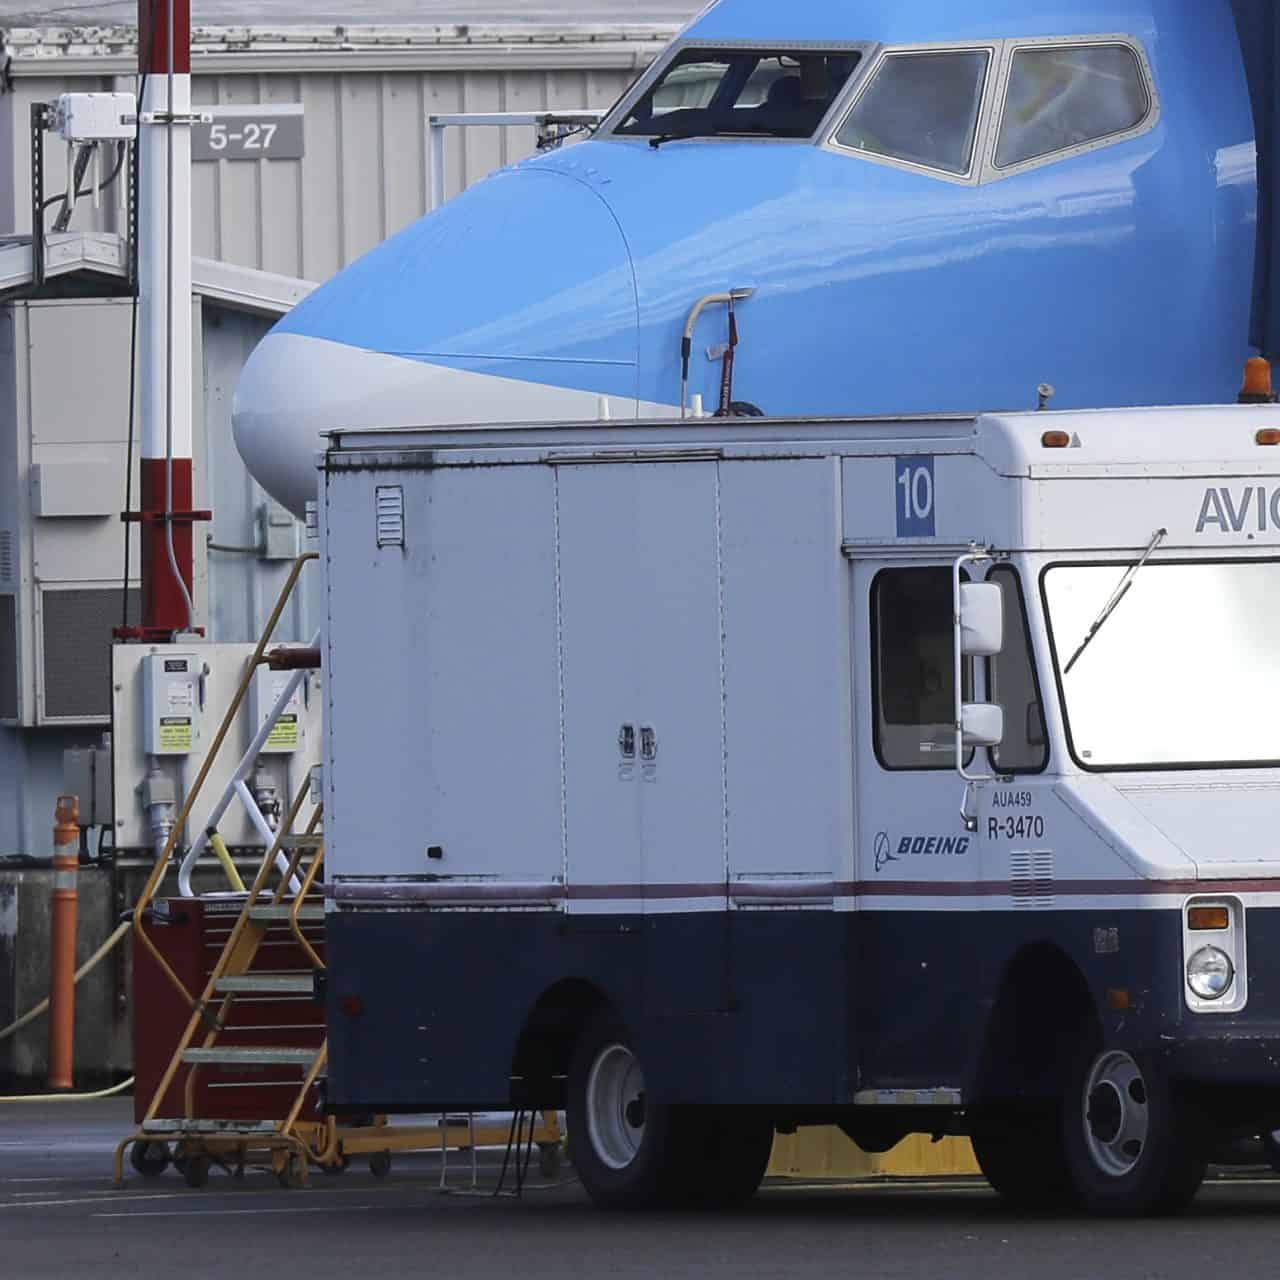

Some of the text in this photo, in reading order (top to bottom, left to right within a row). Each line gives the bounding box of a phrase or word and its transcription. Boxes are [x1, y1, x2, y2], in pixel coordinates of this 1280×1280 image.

[209, 123, 277, 150] 5-27
[898, 466, 932, 519] 10
[992, 791, 1032, 808] AUA459
[987, 815, 1045, 840] R-3470
[897, 836, 970, 855] BOEING
